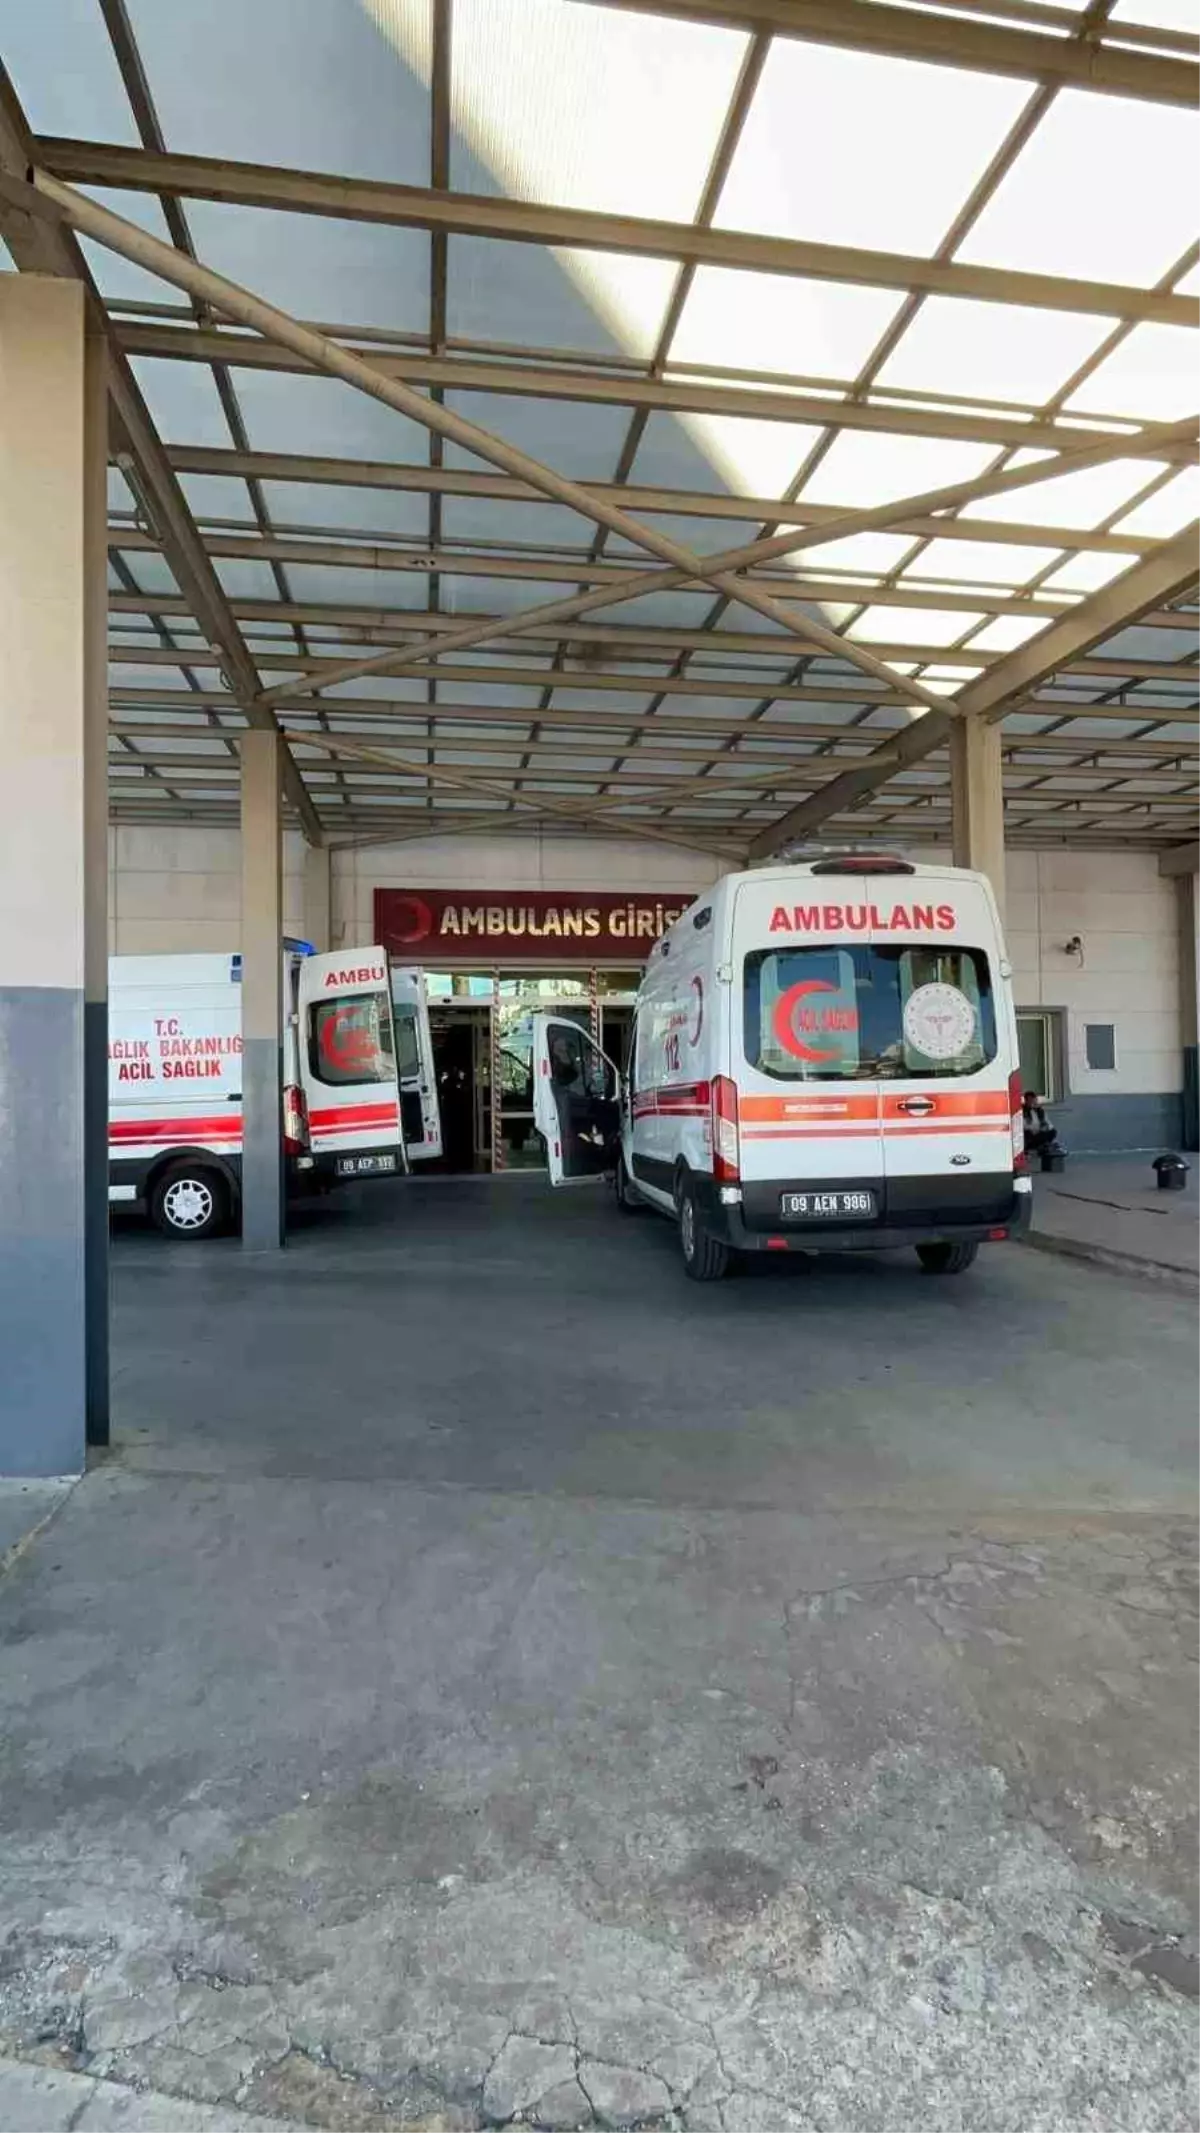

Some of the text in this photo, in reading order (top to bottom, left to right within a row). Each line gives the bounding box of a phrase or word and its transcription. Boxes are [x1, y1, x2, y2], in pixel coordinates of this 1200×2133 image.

[440, 905, 601, 937] AMBULANS
[768, 904, 956, 932] AMBULANS
[325, 967, 385, 987] AMBU
[155, 1018, 184, 1037] T.C.
[119, 1057, 222, 1080] ACİL SAĞLIK
[791, 1196, 807, 1212] 09
[814, 1196, 837, 1211] AEN
